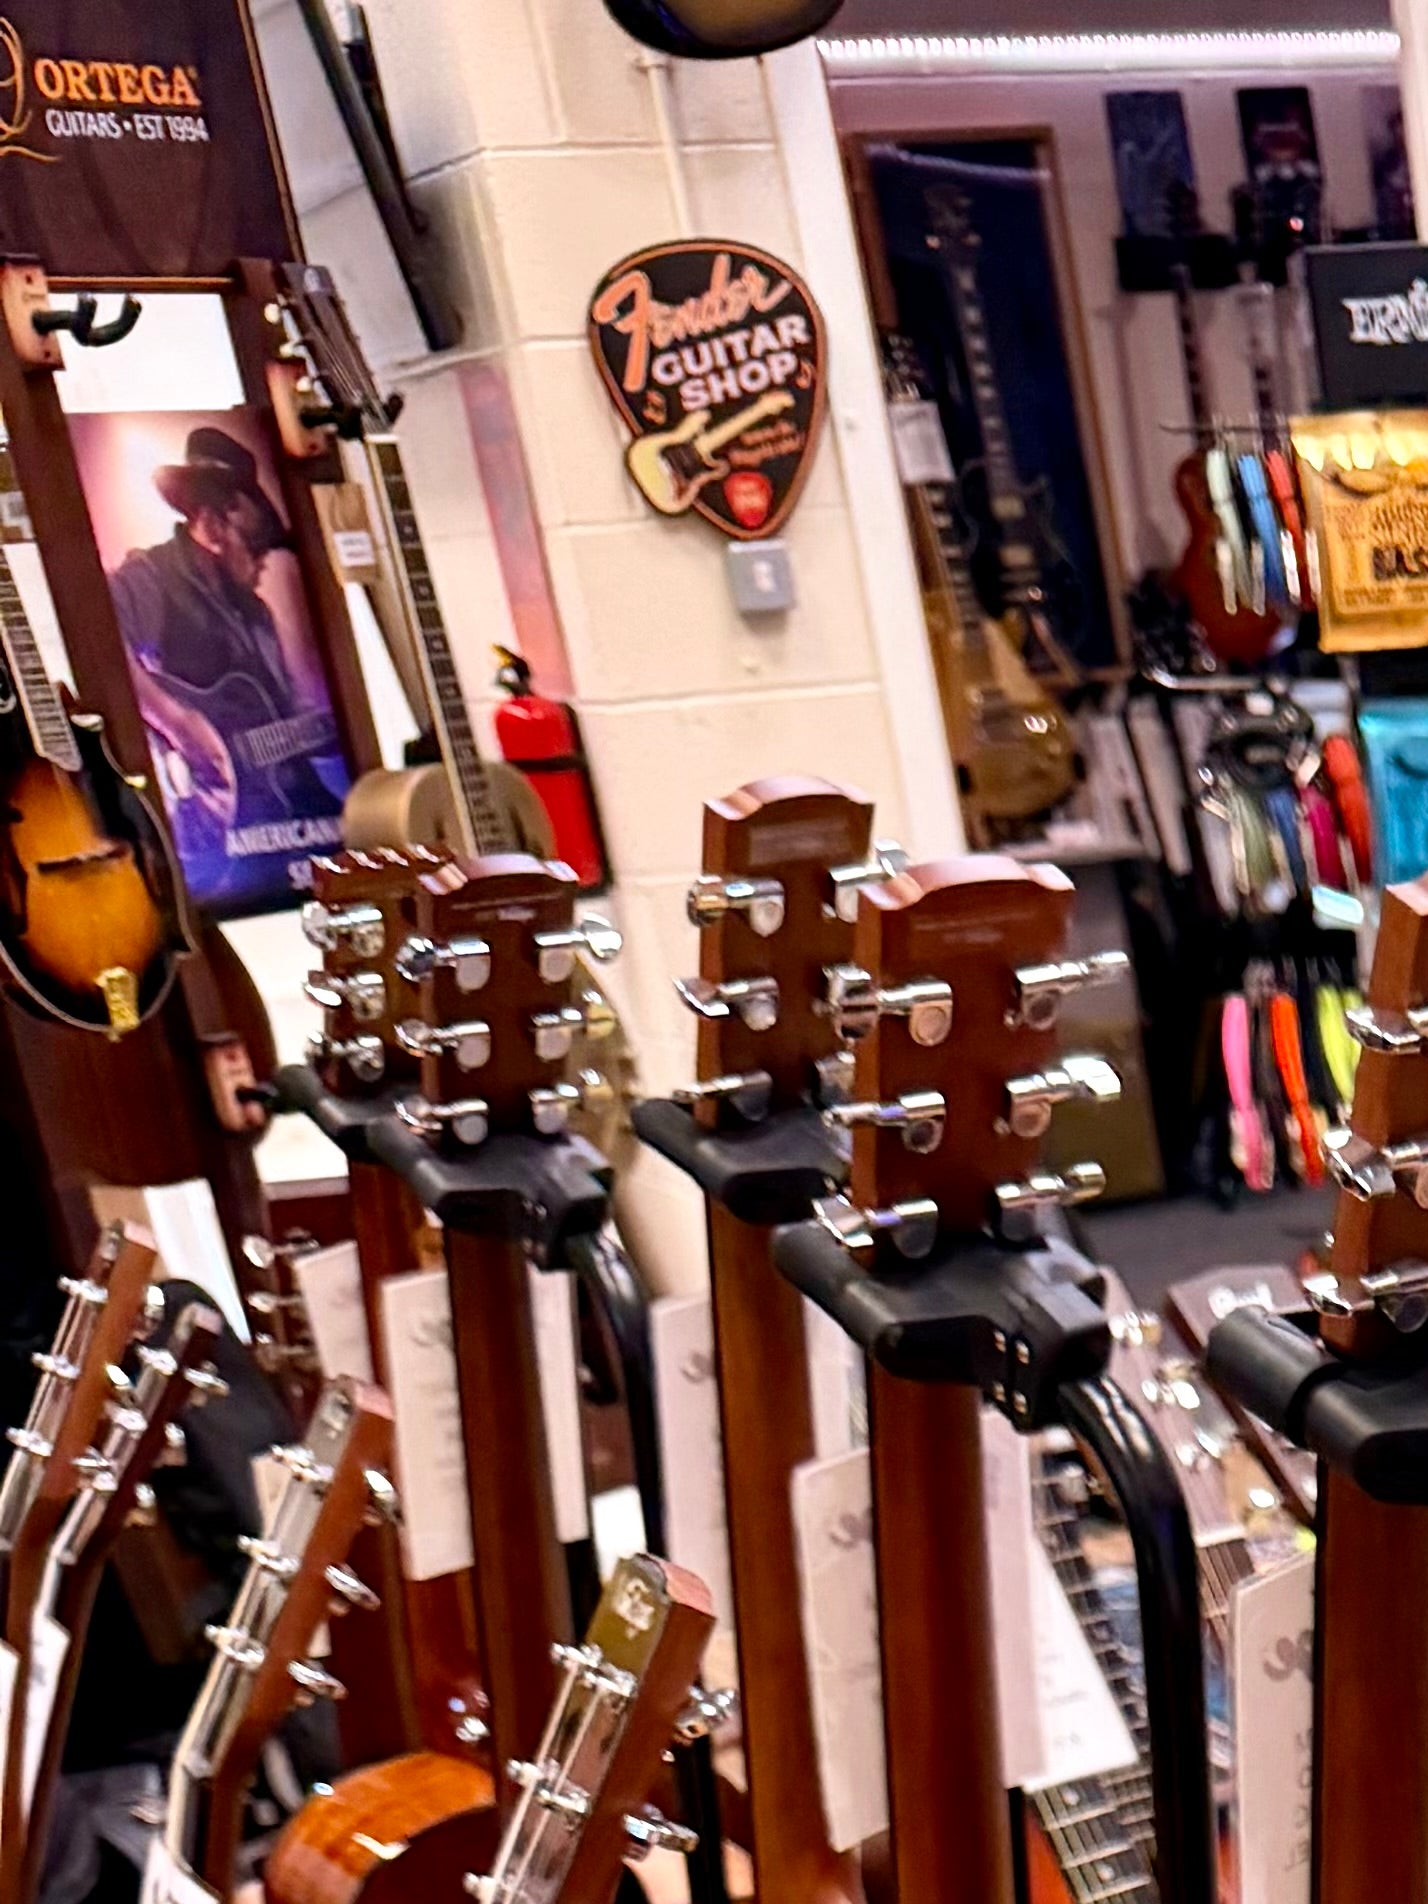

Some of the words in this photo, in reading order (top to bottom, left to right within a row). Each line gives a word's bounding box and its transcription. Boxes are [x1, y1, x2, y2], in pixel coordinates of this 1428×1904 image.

[34, 58, 201, 106] ORTEGA
[45, 109, 124, 138] GUITARS
[133, 113, 165, 140] EST
[165, 115, 211, 141] 1994
[592, 253, 792, 392] Fender
[652, 314, 812, 385] GUITAR
[679, 351, 798, 411] SHOP
